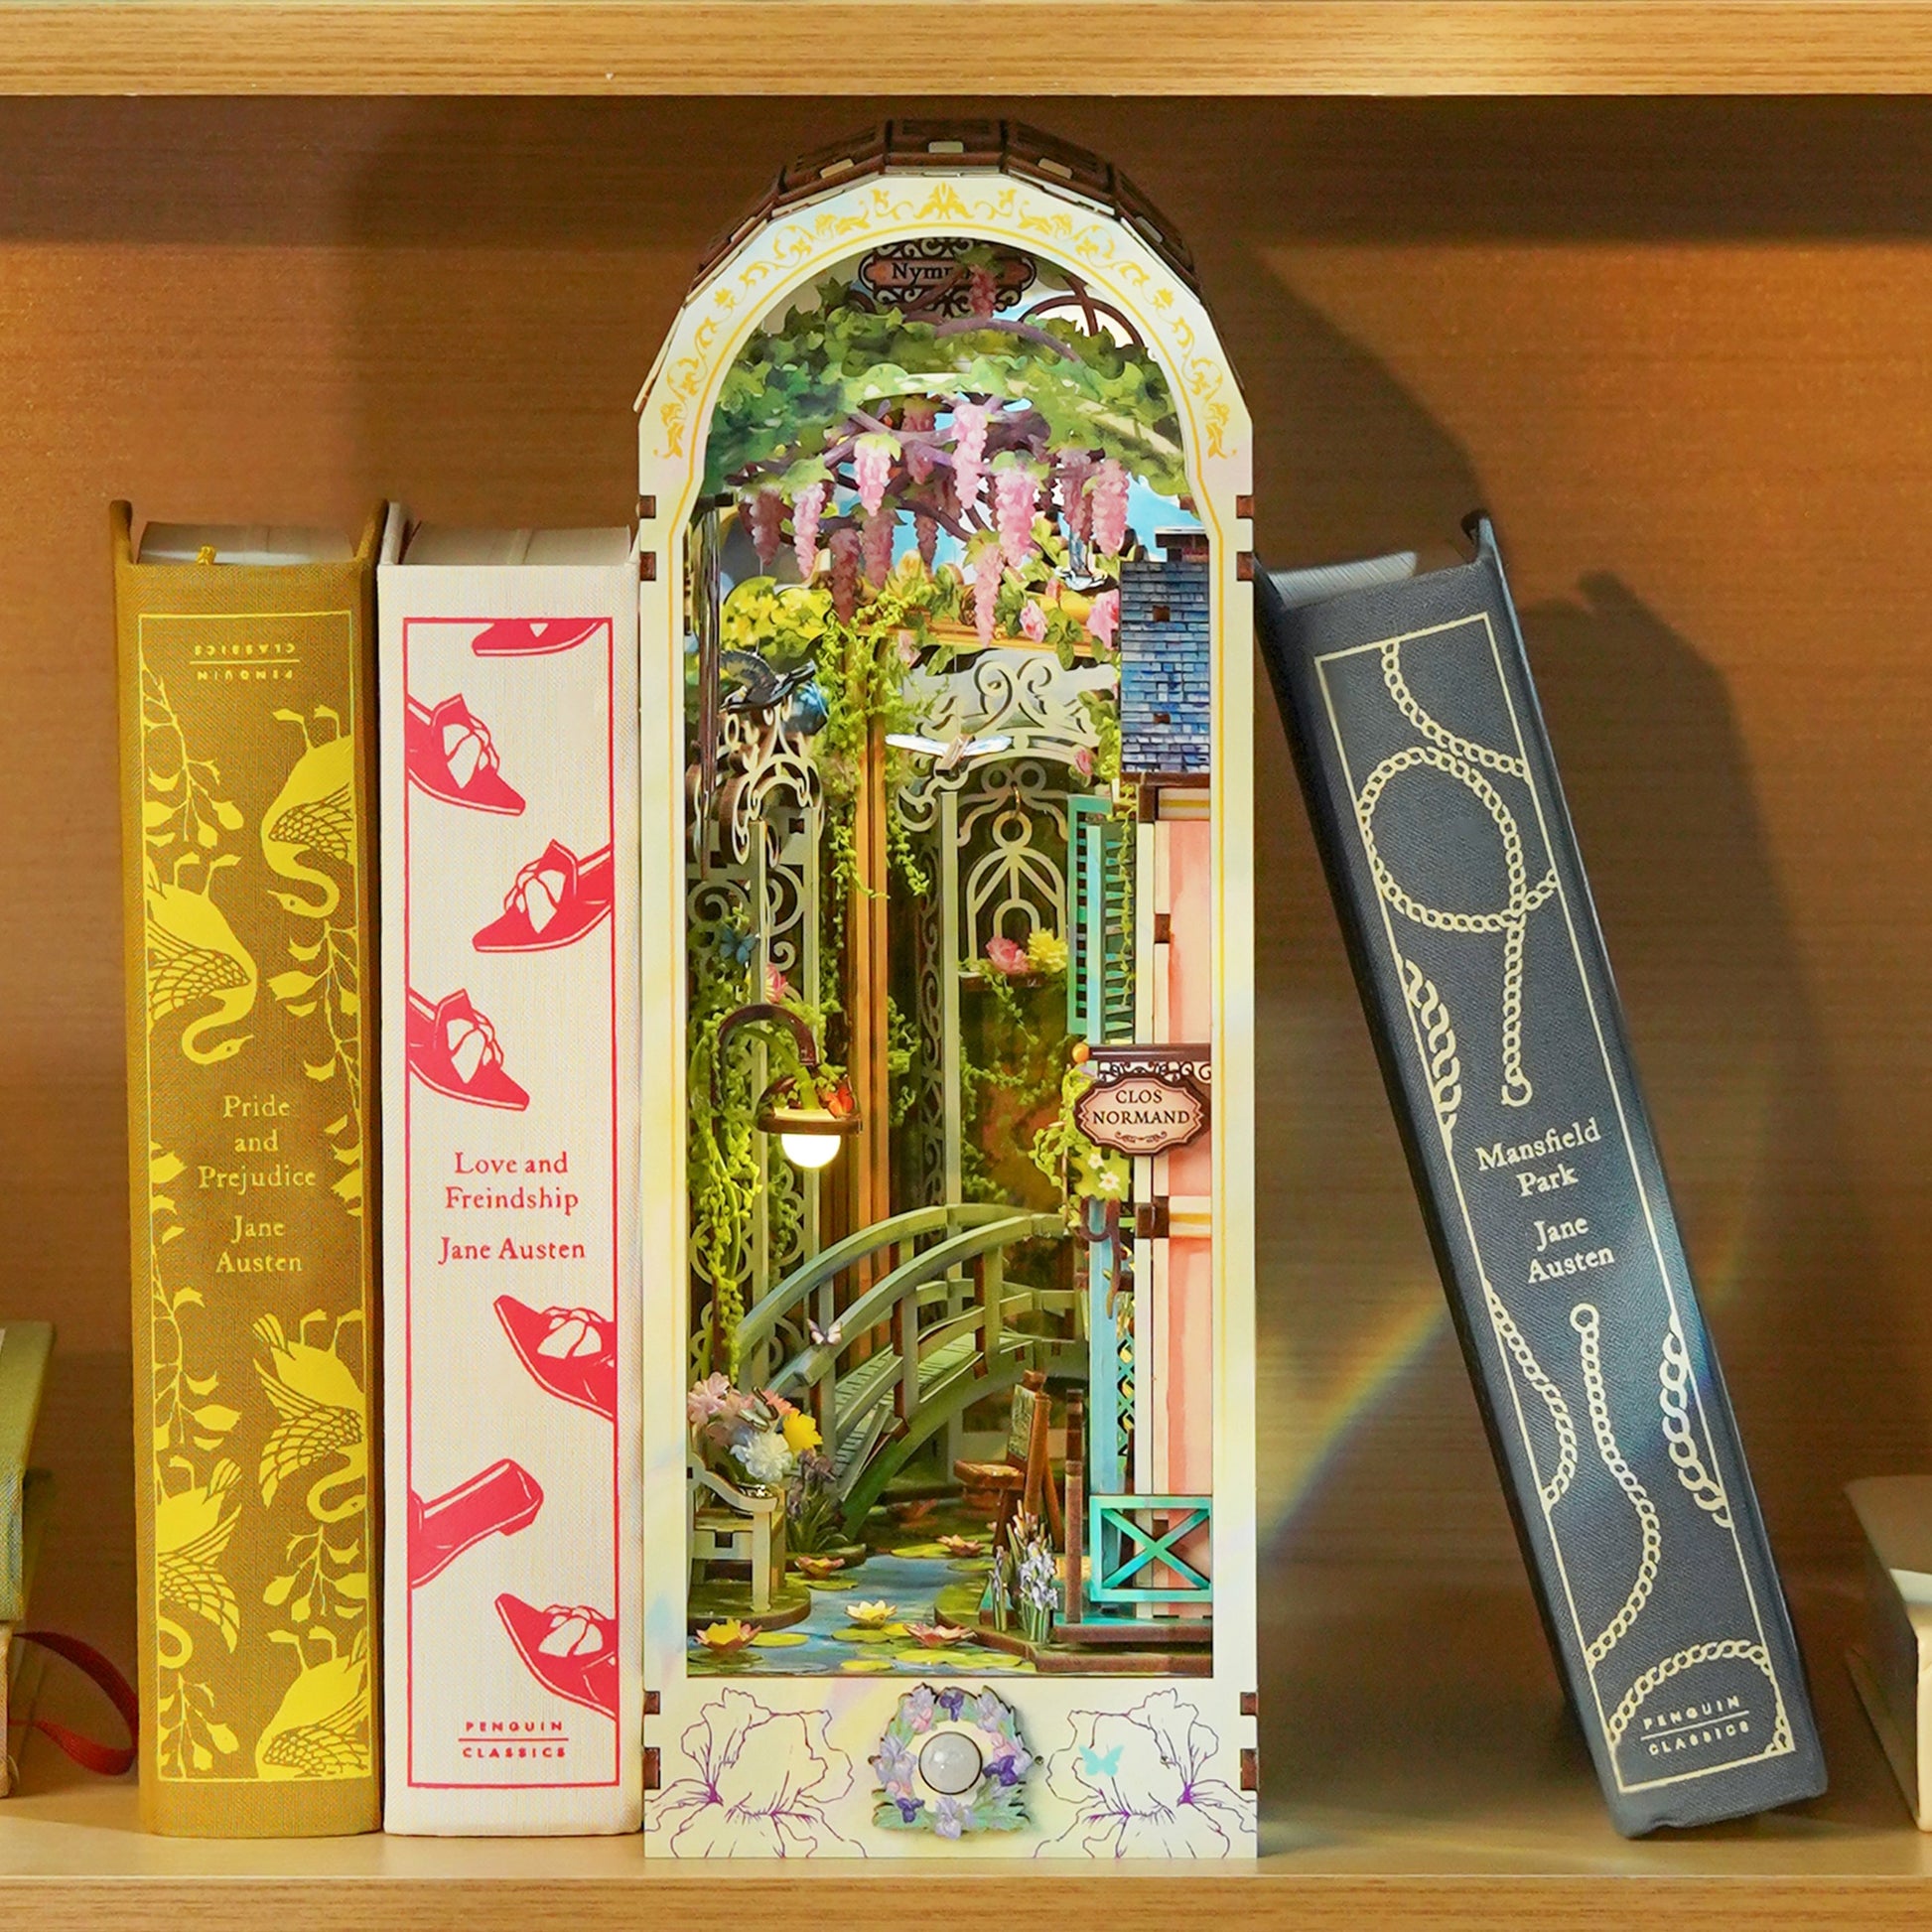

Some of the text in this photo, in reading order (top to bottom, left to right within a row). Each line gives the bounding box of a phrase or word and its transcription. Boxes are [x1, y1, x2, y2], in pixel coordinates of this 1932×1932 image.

[194, 642, 296, 656] CLASSICS
[198, 669, 293, 681] PENGUIN
[222, 1094, 291, 1118] Pride
[1115, 1089, 1163, 1104] CLOS
[1092, 1110, 1190, 1125] NORMAND
[234, 1129, 279, 1153] and
[1474, 1116, 1601, 1172] Mansfield
[455, 1150, 568, 1174] Love and
[198, 1164, 317, 1196] Prejudice
[1515, 1163, 1579, 1197] Park
[445, 1185, 579, 1217] Freindship
[230, 1214, 286, 1244] Jane
[1533, 1217, 1589, 1252] Jane
[215, 1251, 303, 1274] Austen
[437, 1236, 586, 1266] Jane Austen
[1527, 1247, 1615, 1284] Austen
[1643, 1695, 1740, 1730] PENGUIN
[466, 1721, 563, 1732] PENGUIN
[1648, 1720, 1749, 1756] CLASSICS
[462, 1746, 565, 1759] CLASSICS
